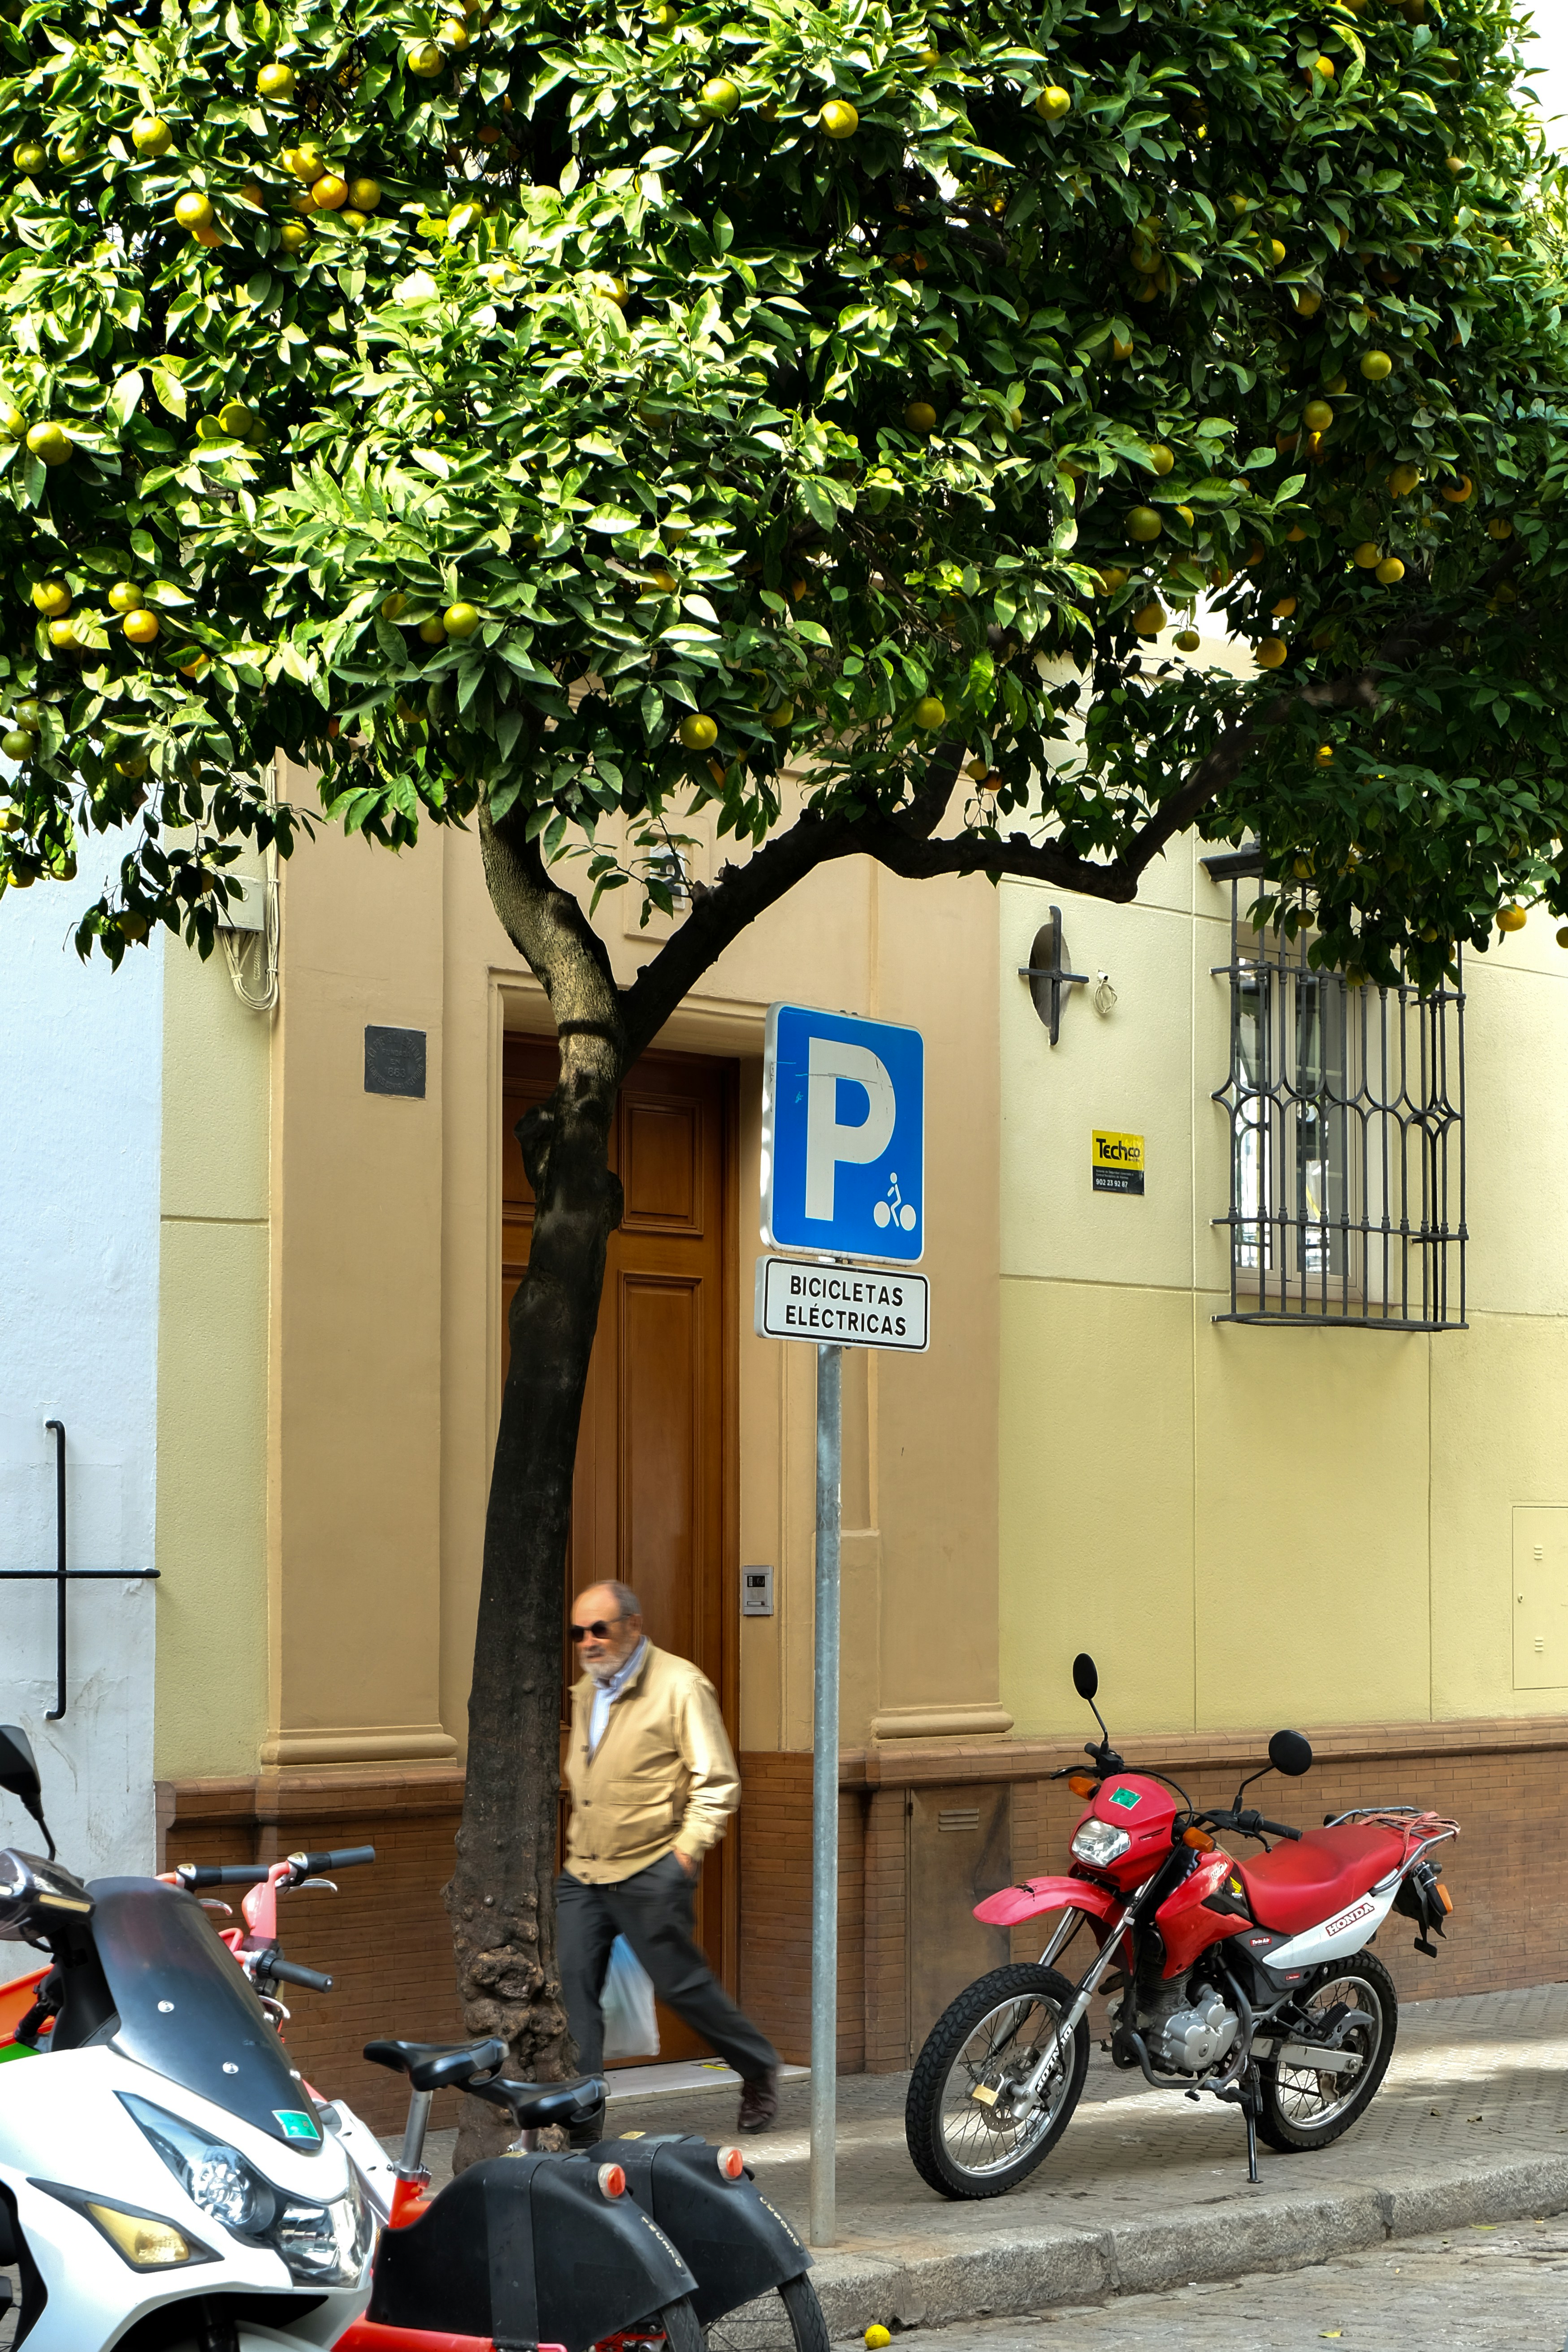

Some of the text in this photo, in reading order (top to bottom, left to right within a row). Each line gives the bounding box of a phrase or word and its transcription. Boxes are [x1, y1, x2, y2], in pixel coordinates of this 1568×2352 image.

[805, 1037, 896, 1221] P
[790, 1275, 903, 1306] BICICLETAS
[786, 1303, 906, 1336] ELÉCTRICAS
[1326, 1903, 1375, 1936] HONDA
